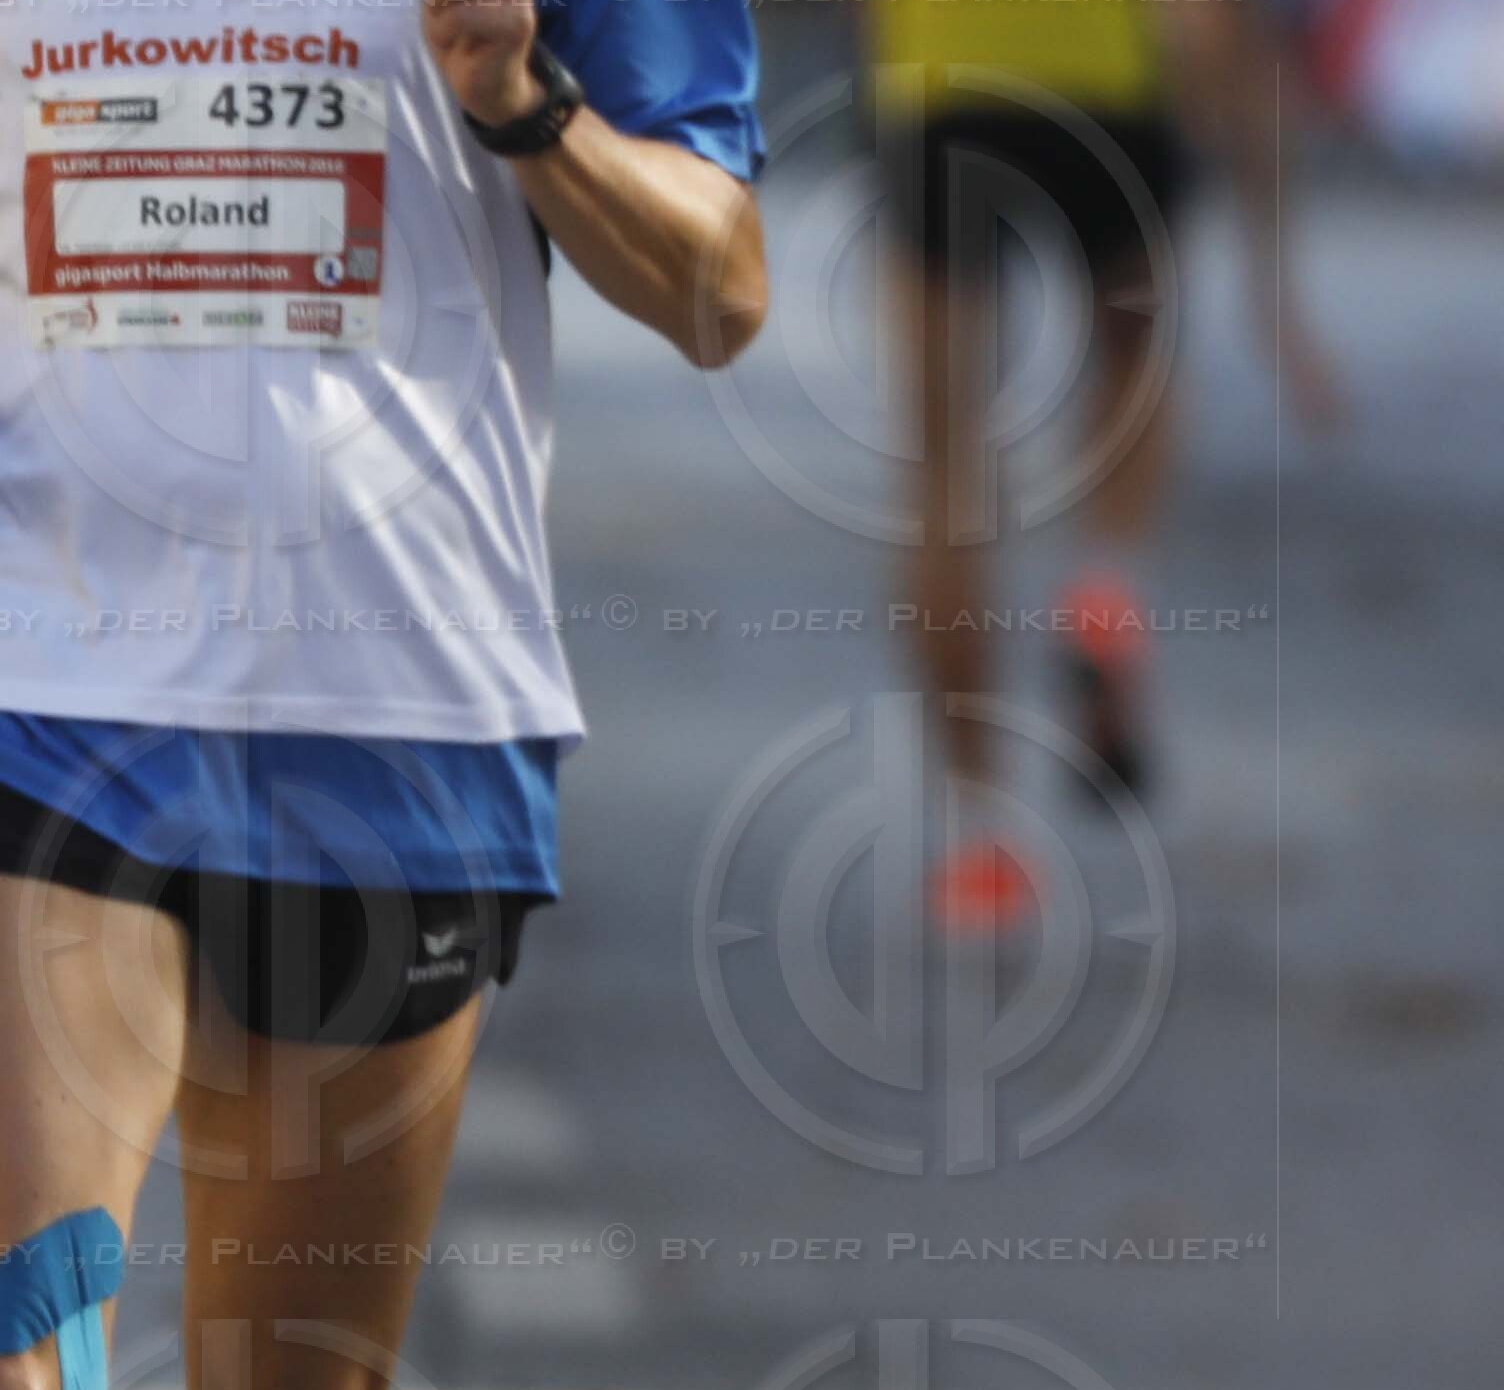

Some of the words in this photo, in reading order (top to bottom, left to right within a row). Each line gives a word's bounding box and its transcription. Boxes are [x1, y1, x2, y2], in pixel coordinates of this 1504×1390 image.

[22, 26, 360, 80] Jurkowitsch
[208, 81, 345, 130] 4373
[141, 195, 269, 226] Roland
[55, 263, 140, 289] gigasport
[146, 260, 290, 281] Halbmarathon
